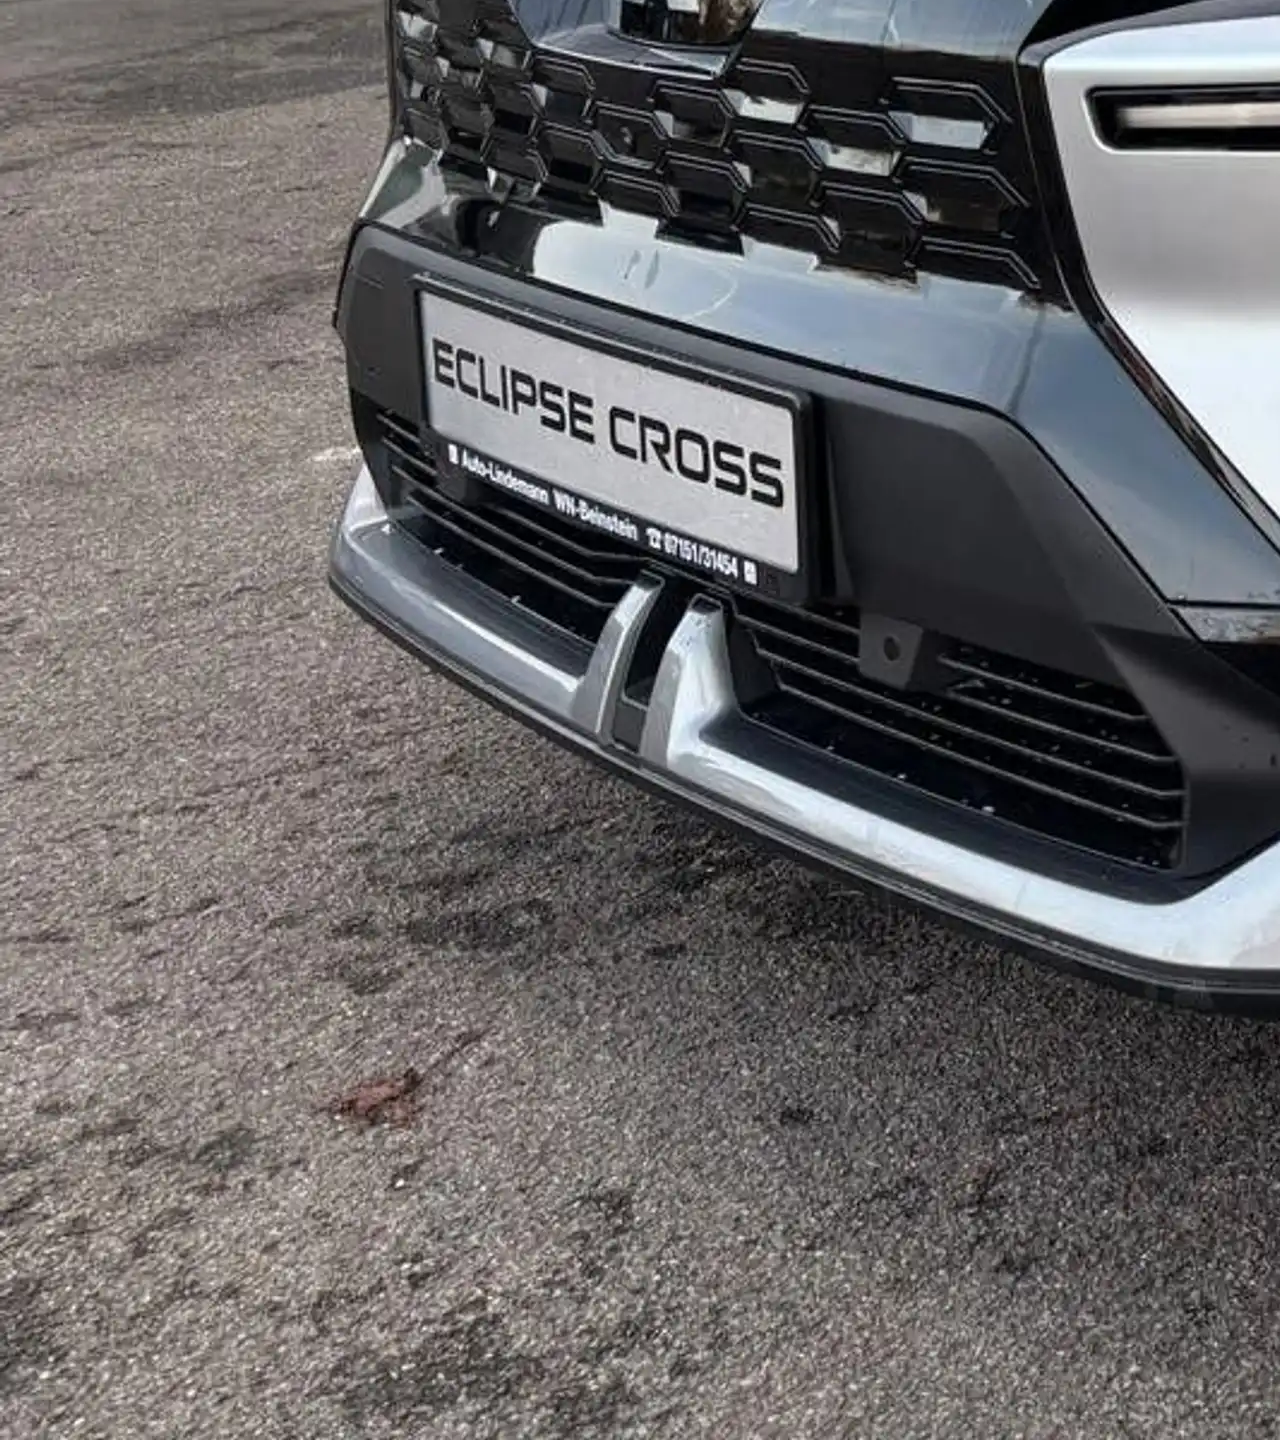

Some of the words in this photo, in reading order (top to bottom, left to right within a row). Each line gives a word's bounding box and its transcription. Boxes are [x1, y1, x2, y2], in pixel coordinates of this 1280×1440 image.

[432, 337, 595, 445] ECLIPSE
[609, 405, 784, 508] CROSS
[461, 449, 549, 505] Auto-Lindemann
